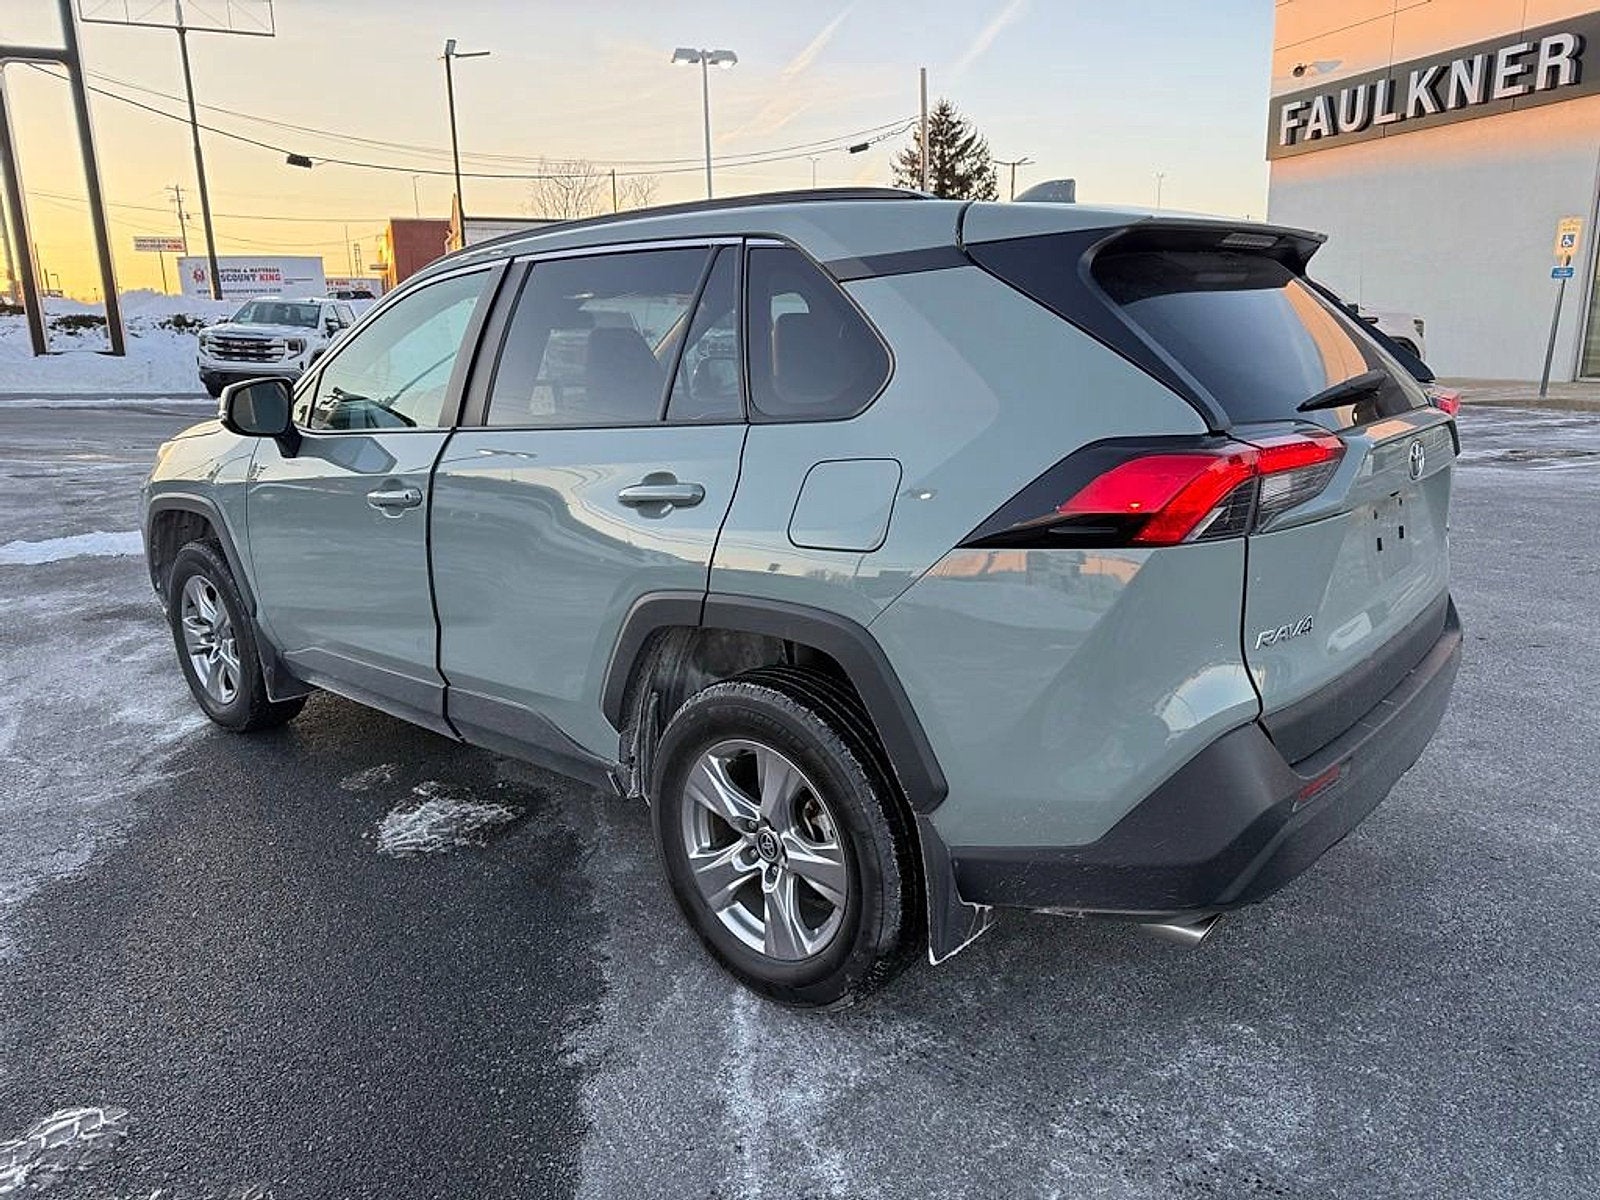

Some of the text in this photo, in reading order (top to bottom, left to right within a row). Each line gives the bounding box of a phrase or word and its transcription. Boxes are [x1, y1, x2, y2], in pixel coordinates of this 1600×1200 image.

[1279, 32, 1585, 146] FAULKNER
[220, 273, 257, 281] SCOUNT
[1255, 614, 1314, 650] RAV4
